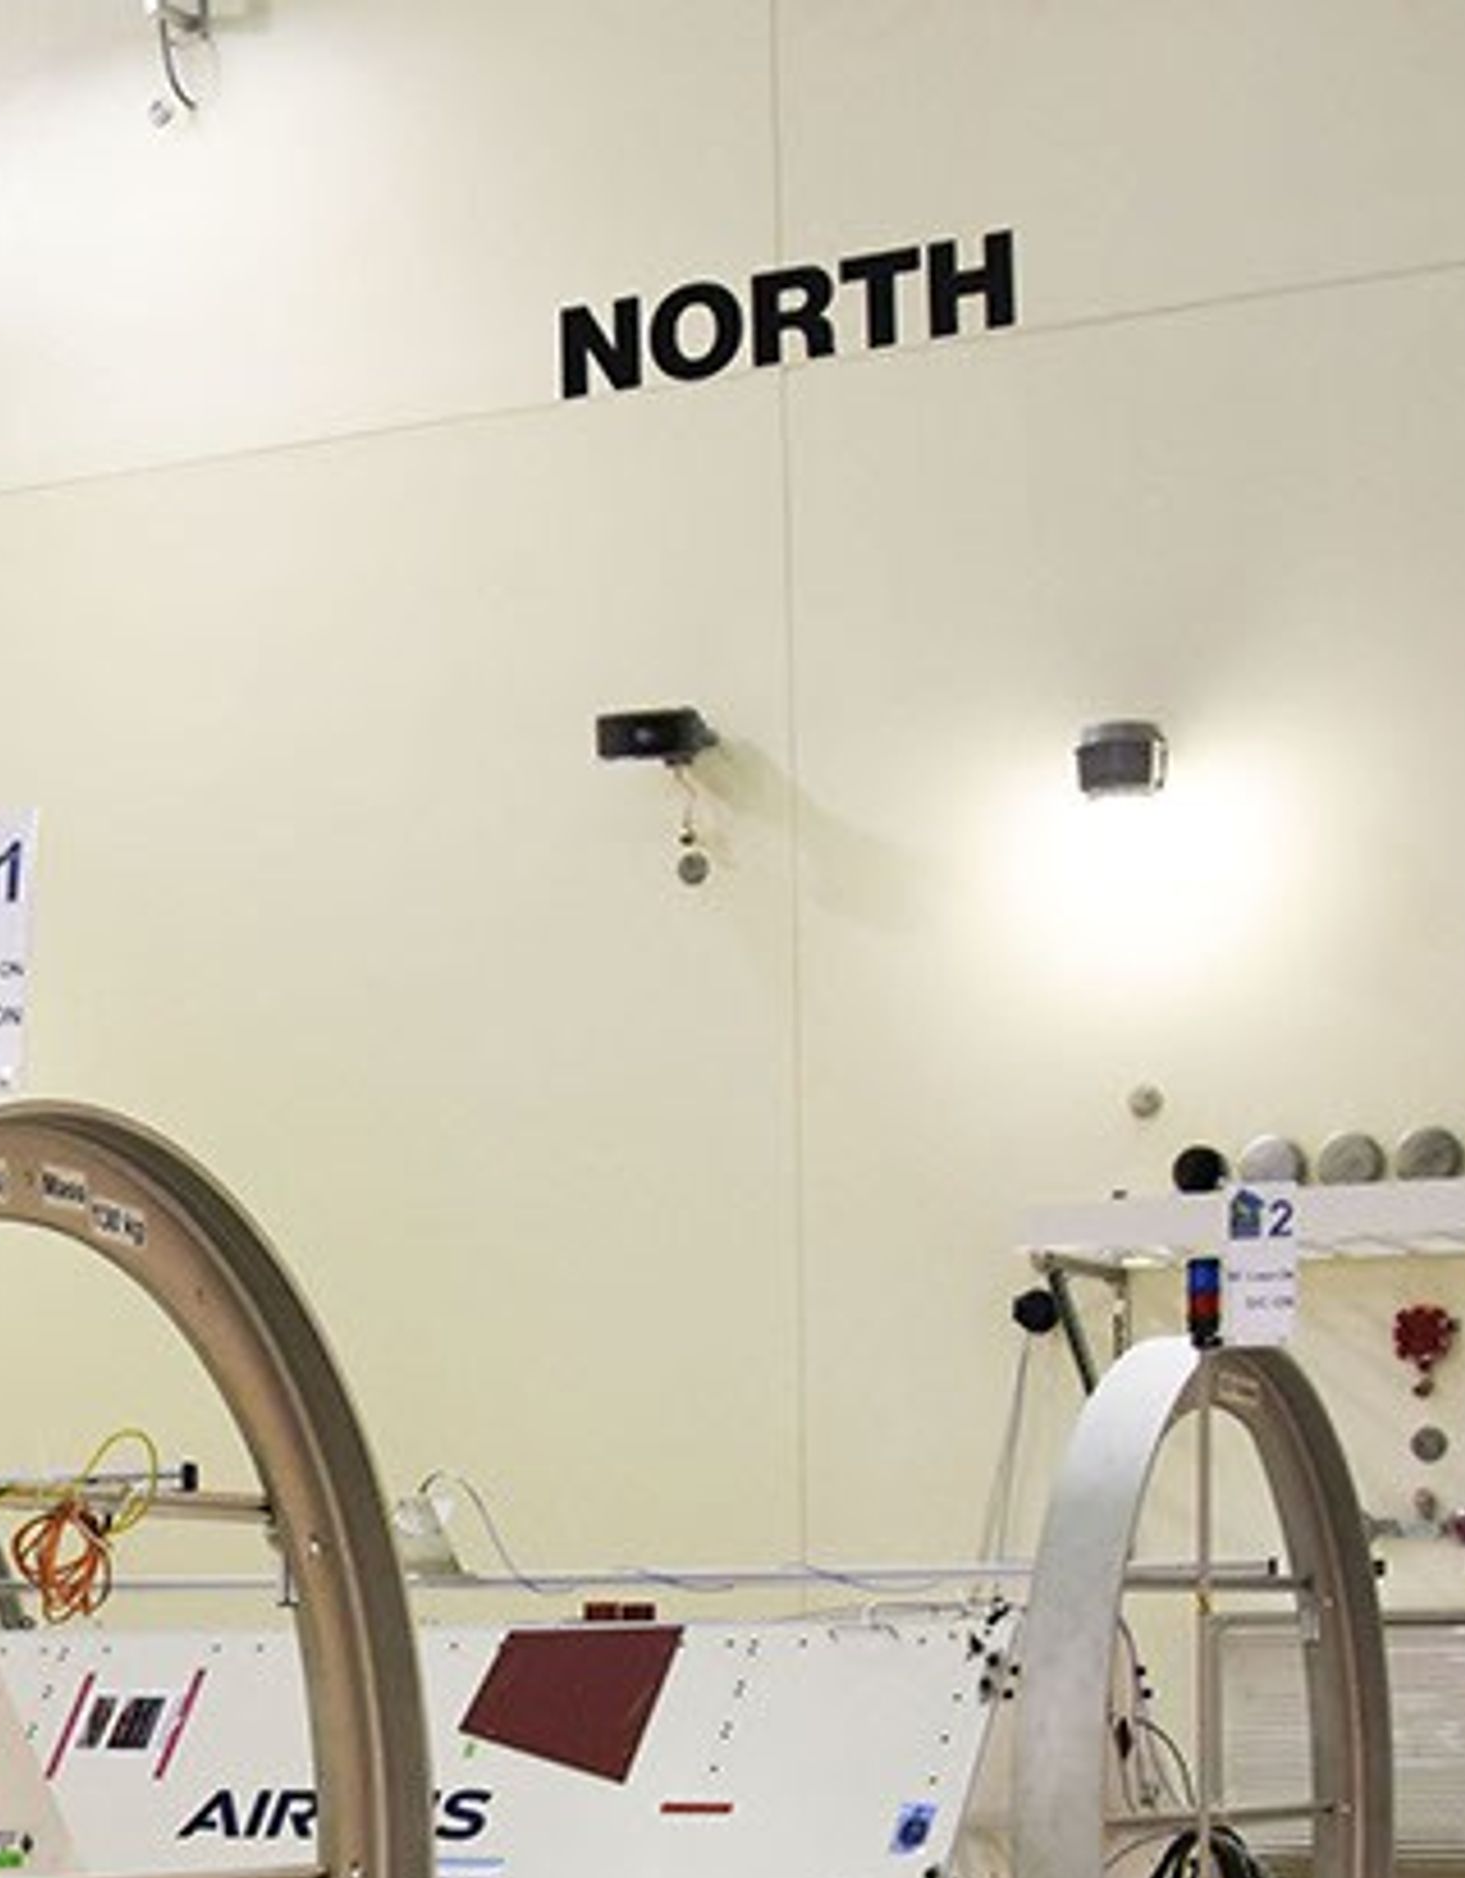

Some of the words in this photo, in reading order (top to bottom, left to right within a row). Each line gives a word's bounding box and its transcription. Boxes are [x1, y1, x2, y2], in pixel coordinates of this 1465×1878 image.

[561, 230, 1015, 399] NORTH
[1269, 1199, 1294, 1237] 2
[177, 1788, 492, 1840] AIRS
